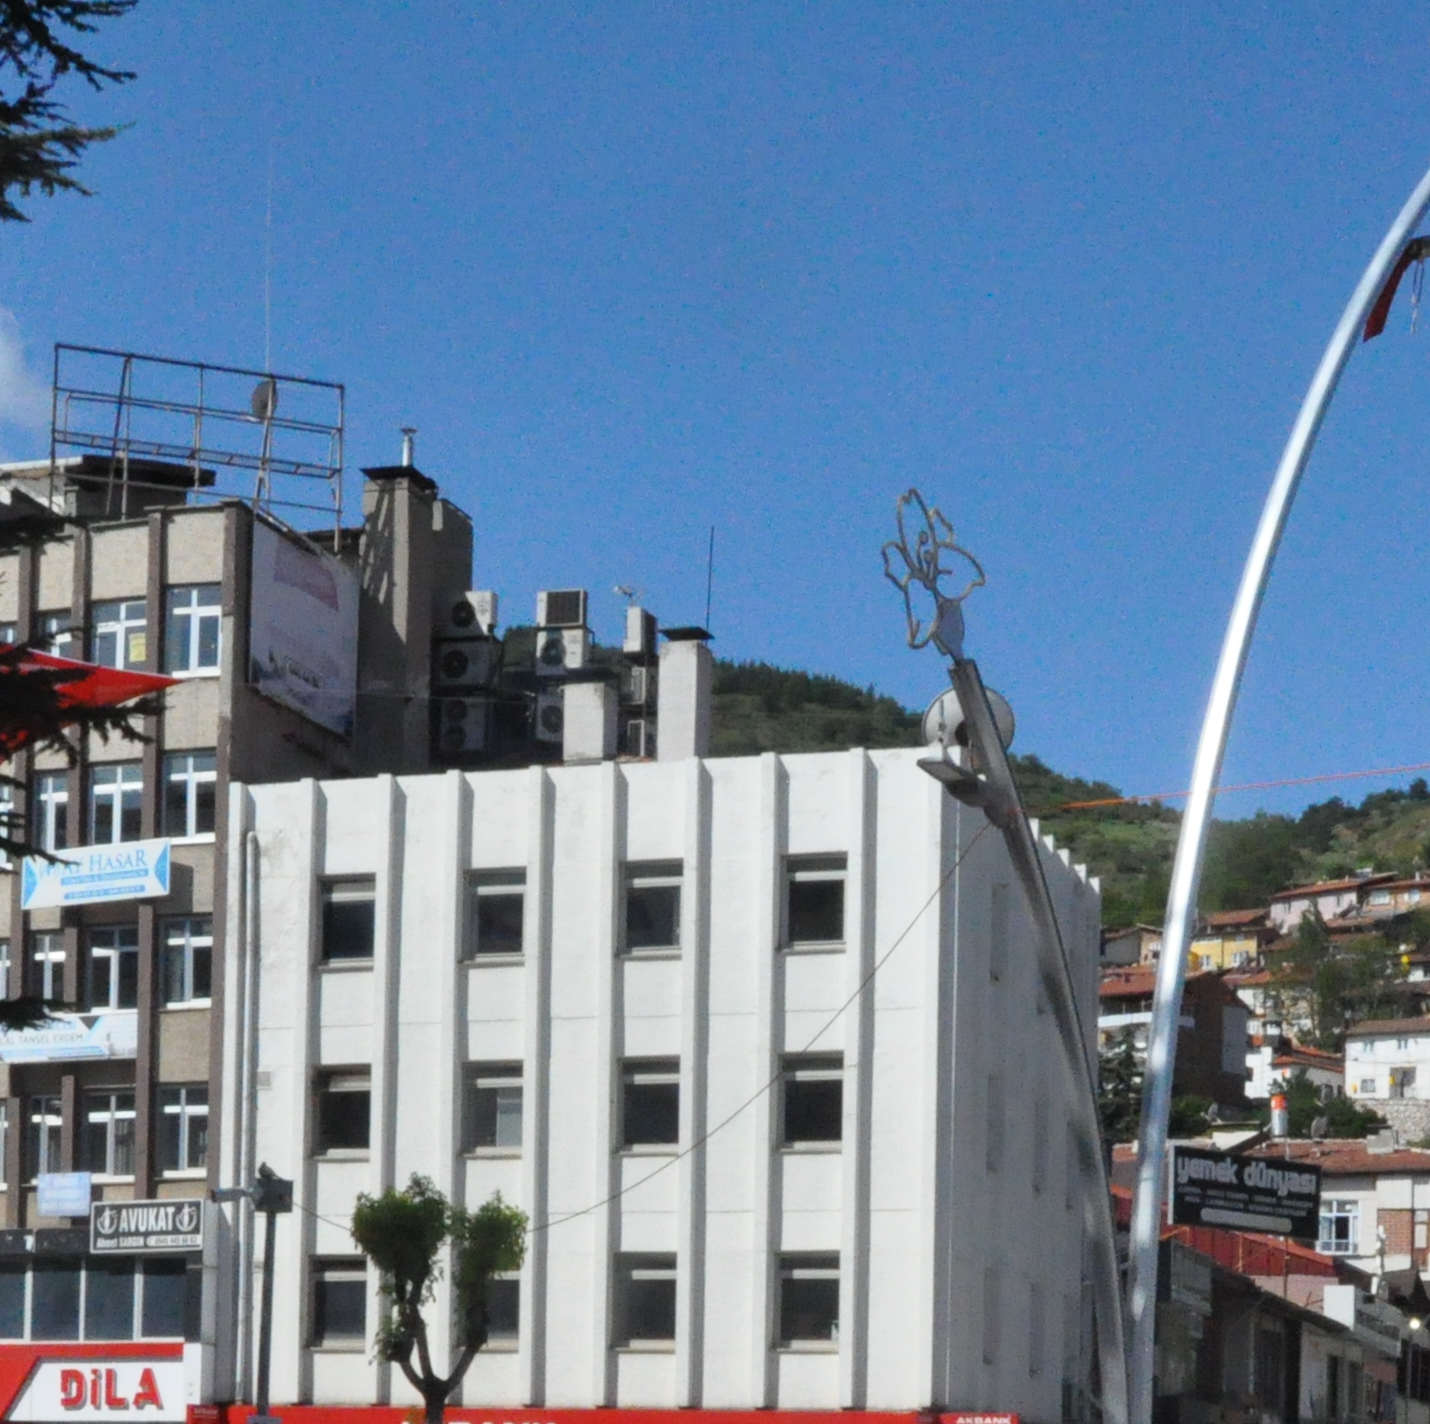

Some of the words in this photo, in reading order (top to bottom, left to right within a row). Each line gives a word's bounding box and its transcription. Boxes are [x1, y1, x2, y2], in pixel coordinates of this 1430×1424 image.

[1177, 1155, 1239, 1185] yemek
[1243, 1160, 1318, 1197] dünyası
[118, 1206, 176, 1233] AVUKAT
